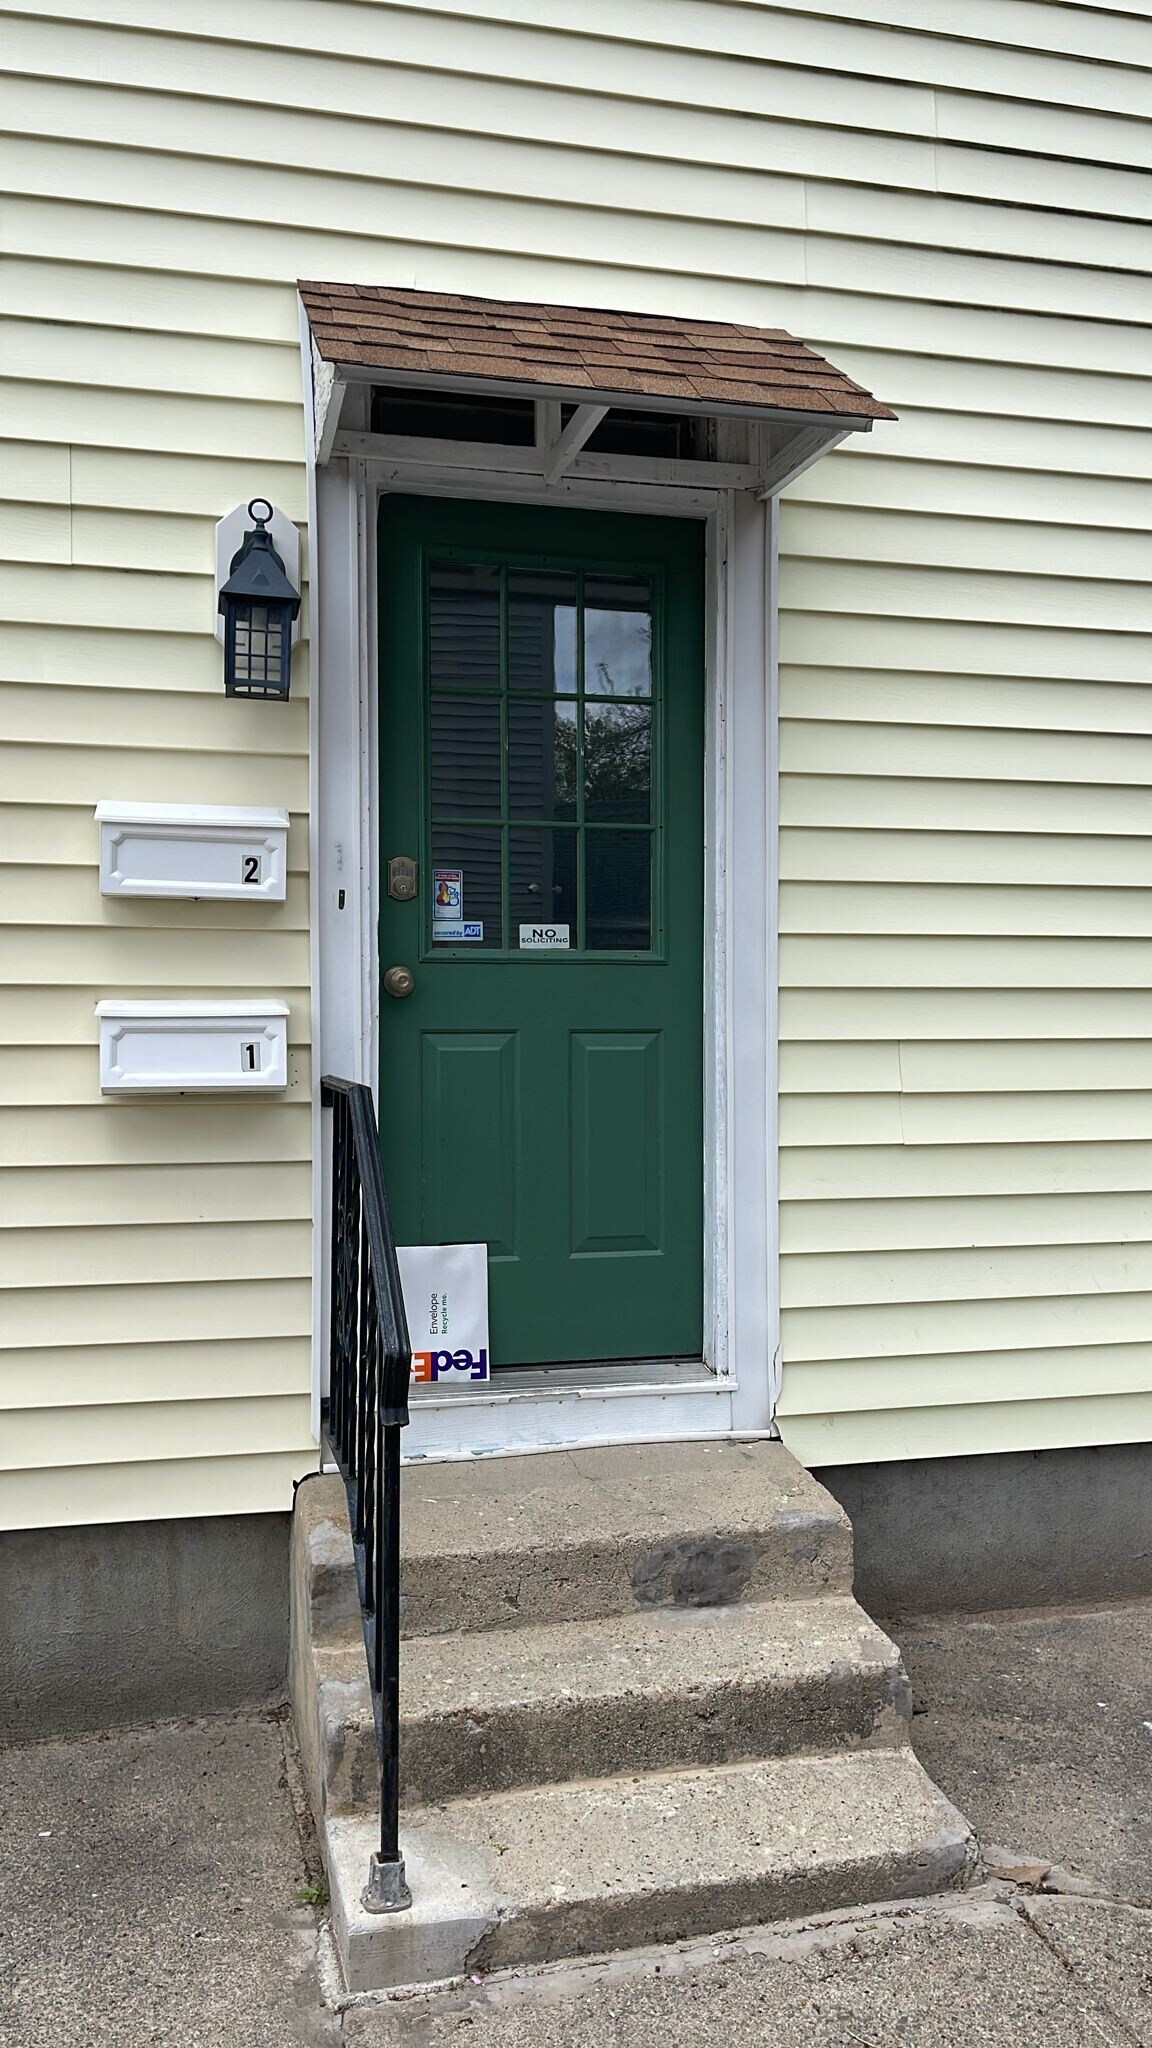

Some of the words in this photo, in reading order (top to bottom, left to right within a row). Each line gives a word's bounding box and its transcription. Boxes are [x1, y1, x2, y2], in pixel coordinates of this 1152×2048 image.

[245, 858, 258, 883] 2
[465, 926, 480, 936] ADT
[532, 929, 557, 938] NO
[245, 1044, 255, 1070] 1
[430, 1293, 439, 1335] Envelope
[441, 1307, 449, 1335] Recycle
[411, 1349, 487, 1382] FedE
